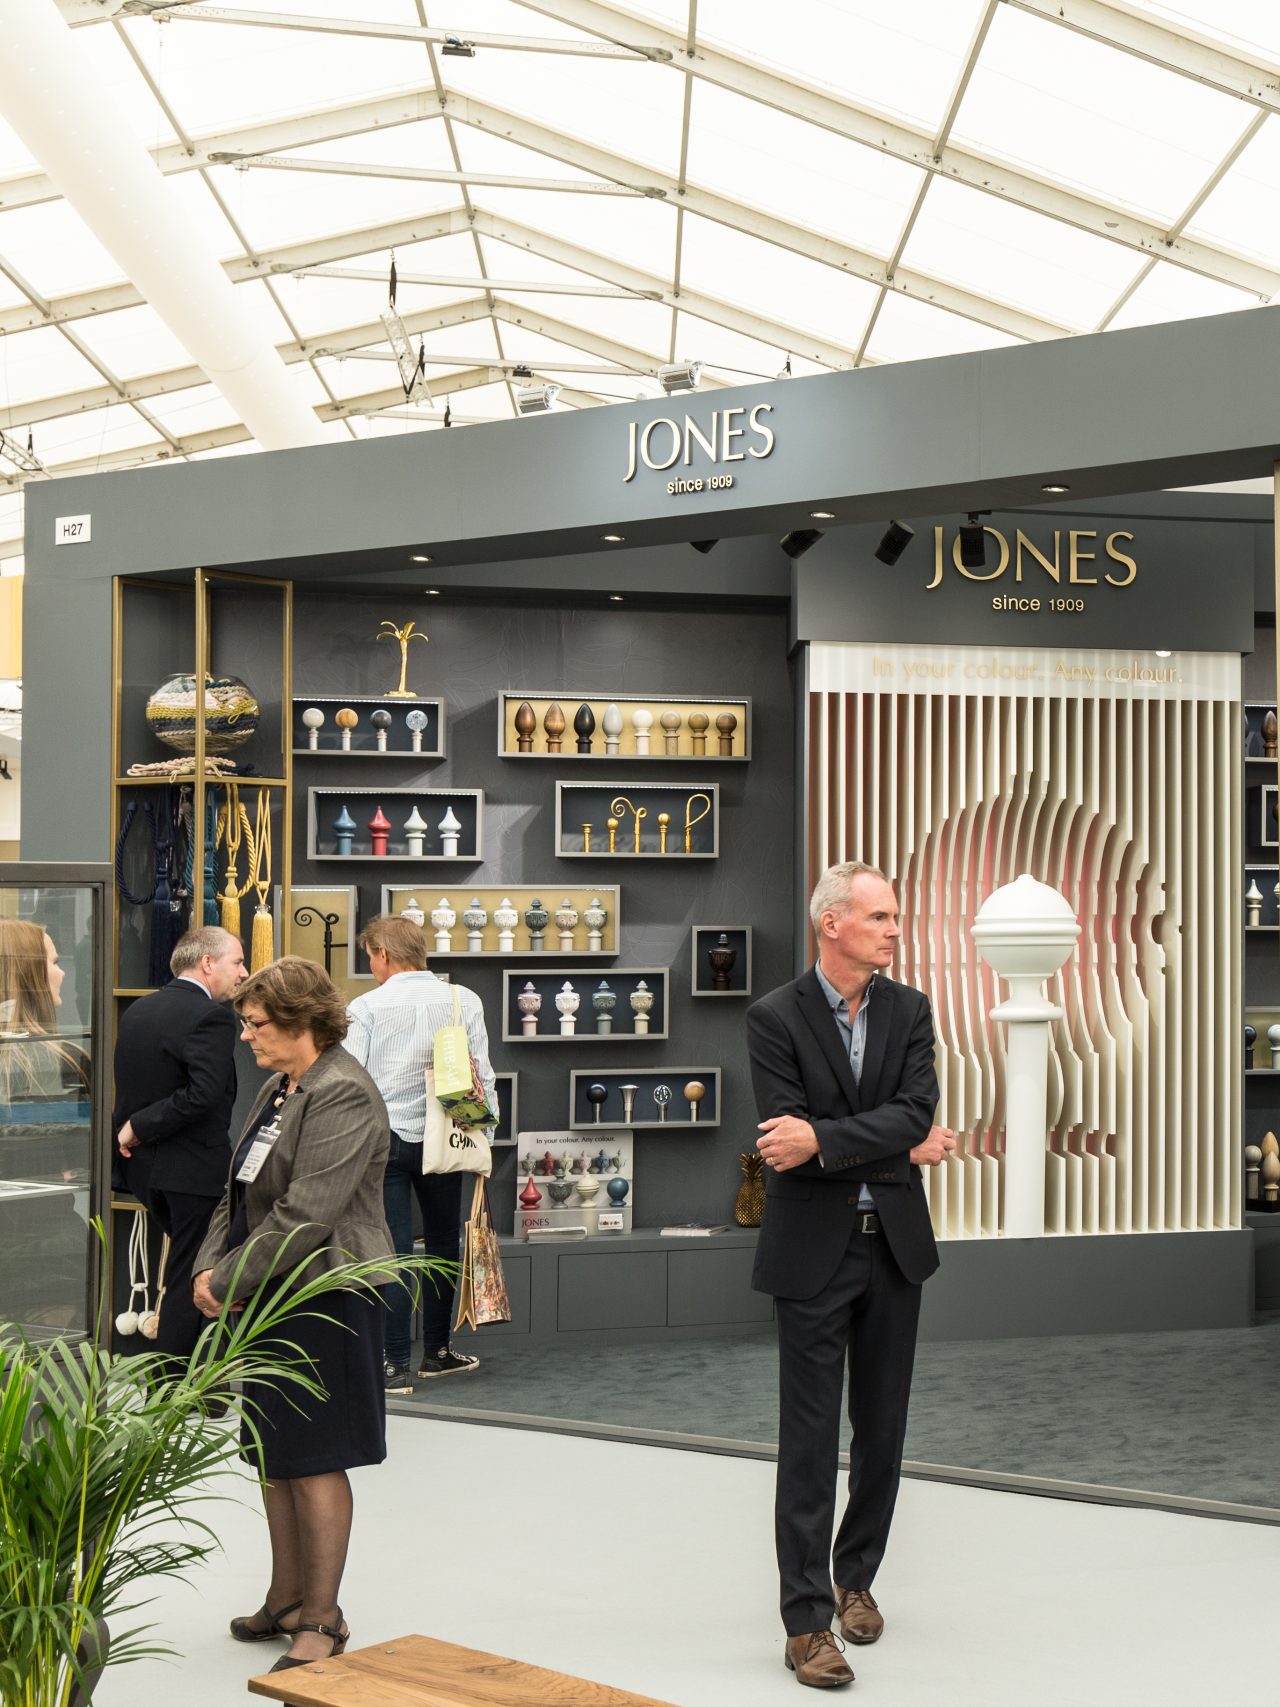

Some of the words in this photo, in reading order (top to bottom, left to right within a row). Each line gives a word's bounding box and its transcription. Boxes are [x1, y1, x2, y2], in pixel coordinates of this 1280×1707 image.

[622, 403, 774, 482] JONES
[667, 477, 703, 494] since
[706, 474, 734, 490] 1909
[63, 523, 83, 537] H27
[926, 526, 1137, 589] JONES
[992, 595, 1041, 611] since
[1048, 599, 1085, 611] 1909
[872, 655, 894, 677] In
[902, 661, 954, 684] your
[963, 657, 1044, 681] colour.
[1054, 659, 1097, 686] Any
[1104, 661, 1184, 684] colour.
[581, 1136, 593, 1144] Any
[522, 1218, 550, 1228] JONES
